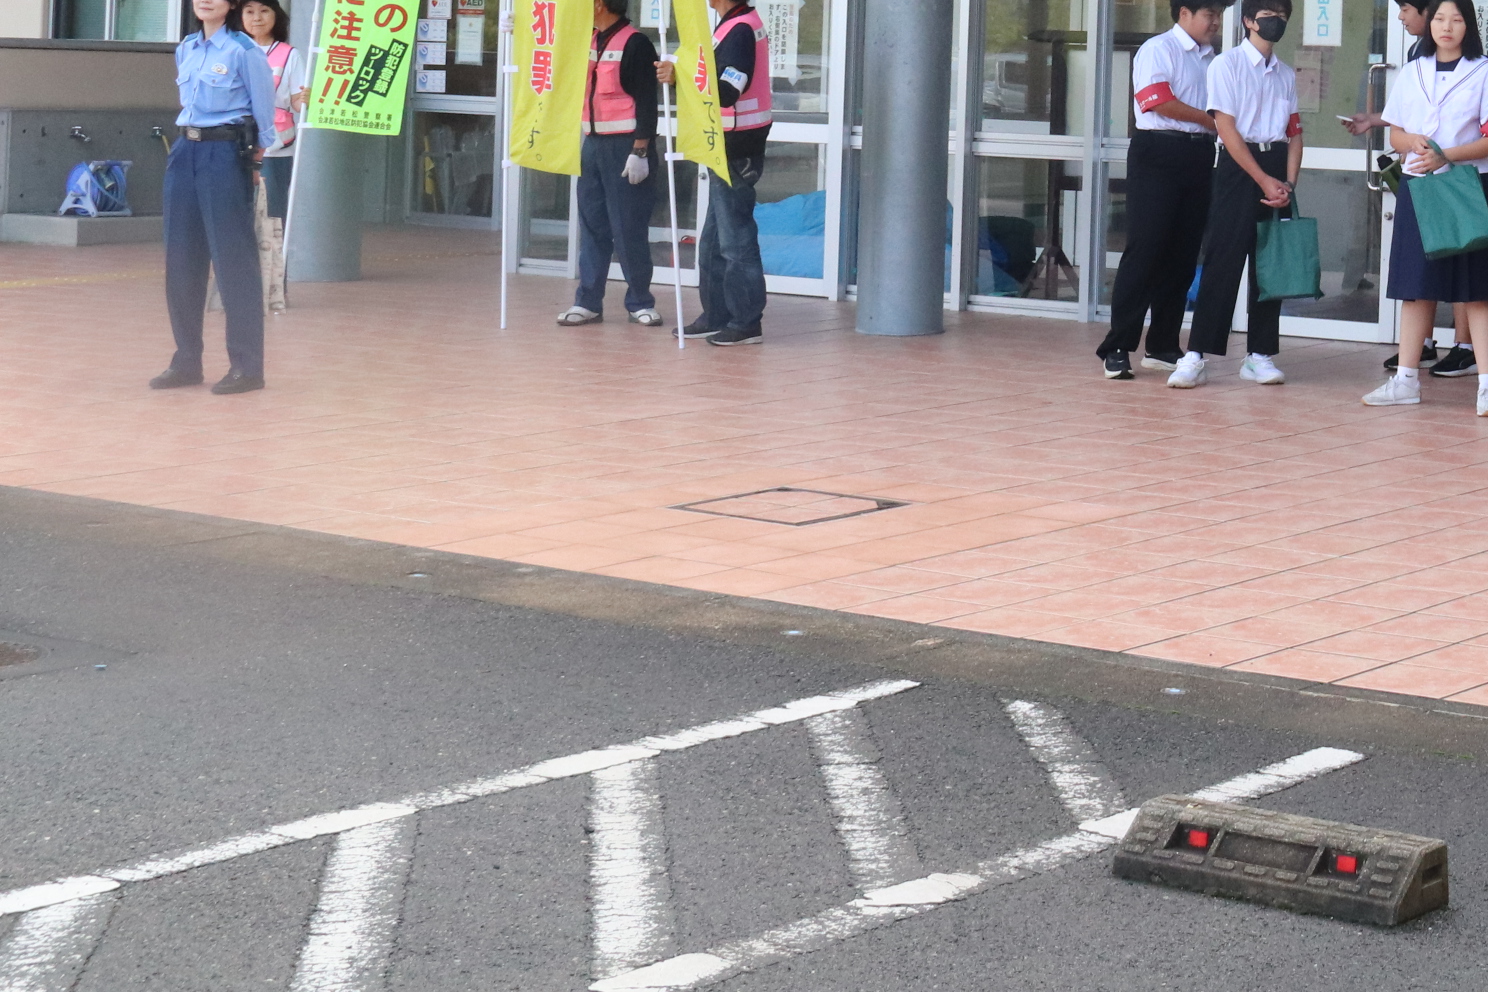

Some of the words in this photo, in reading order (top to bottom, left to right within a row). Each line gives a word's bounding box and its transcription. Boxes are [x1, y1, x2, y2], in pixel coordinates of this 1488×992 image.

[350, 47, 384, 103] ツーロック
[373, 42, 405, 94] 防犯登録
